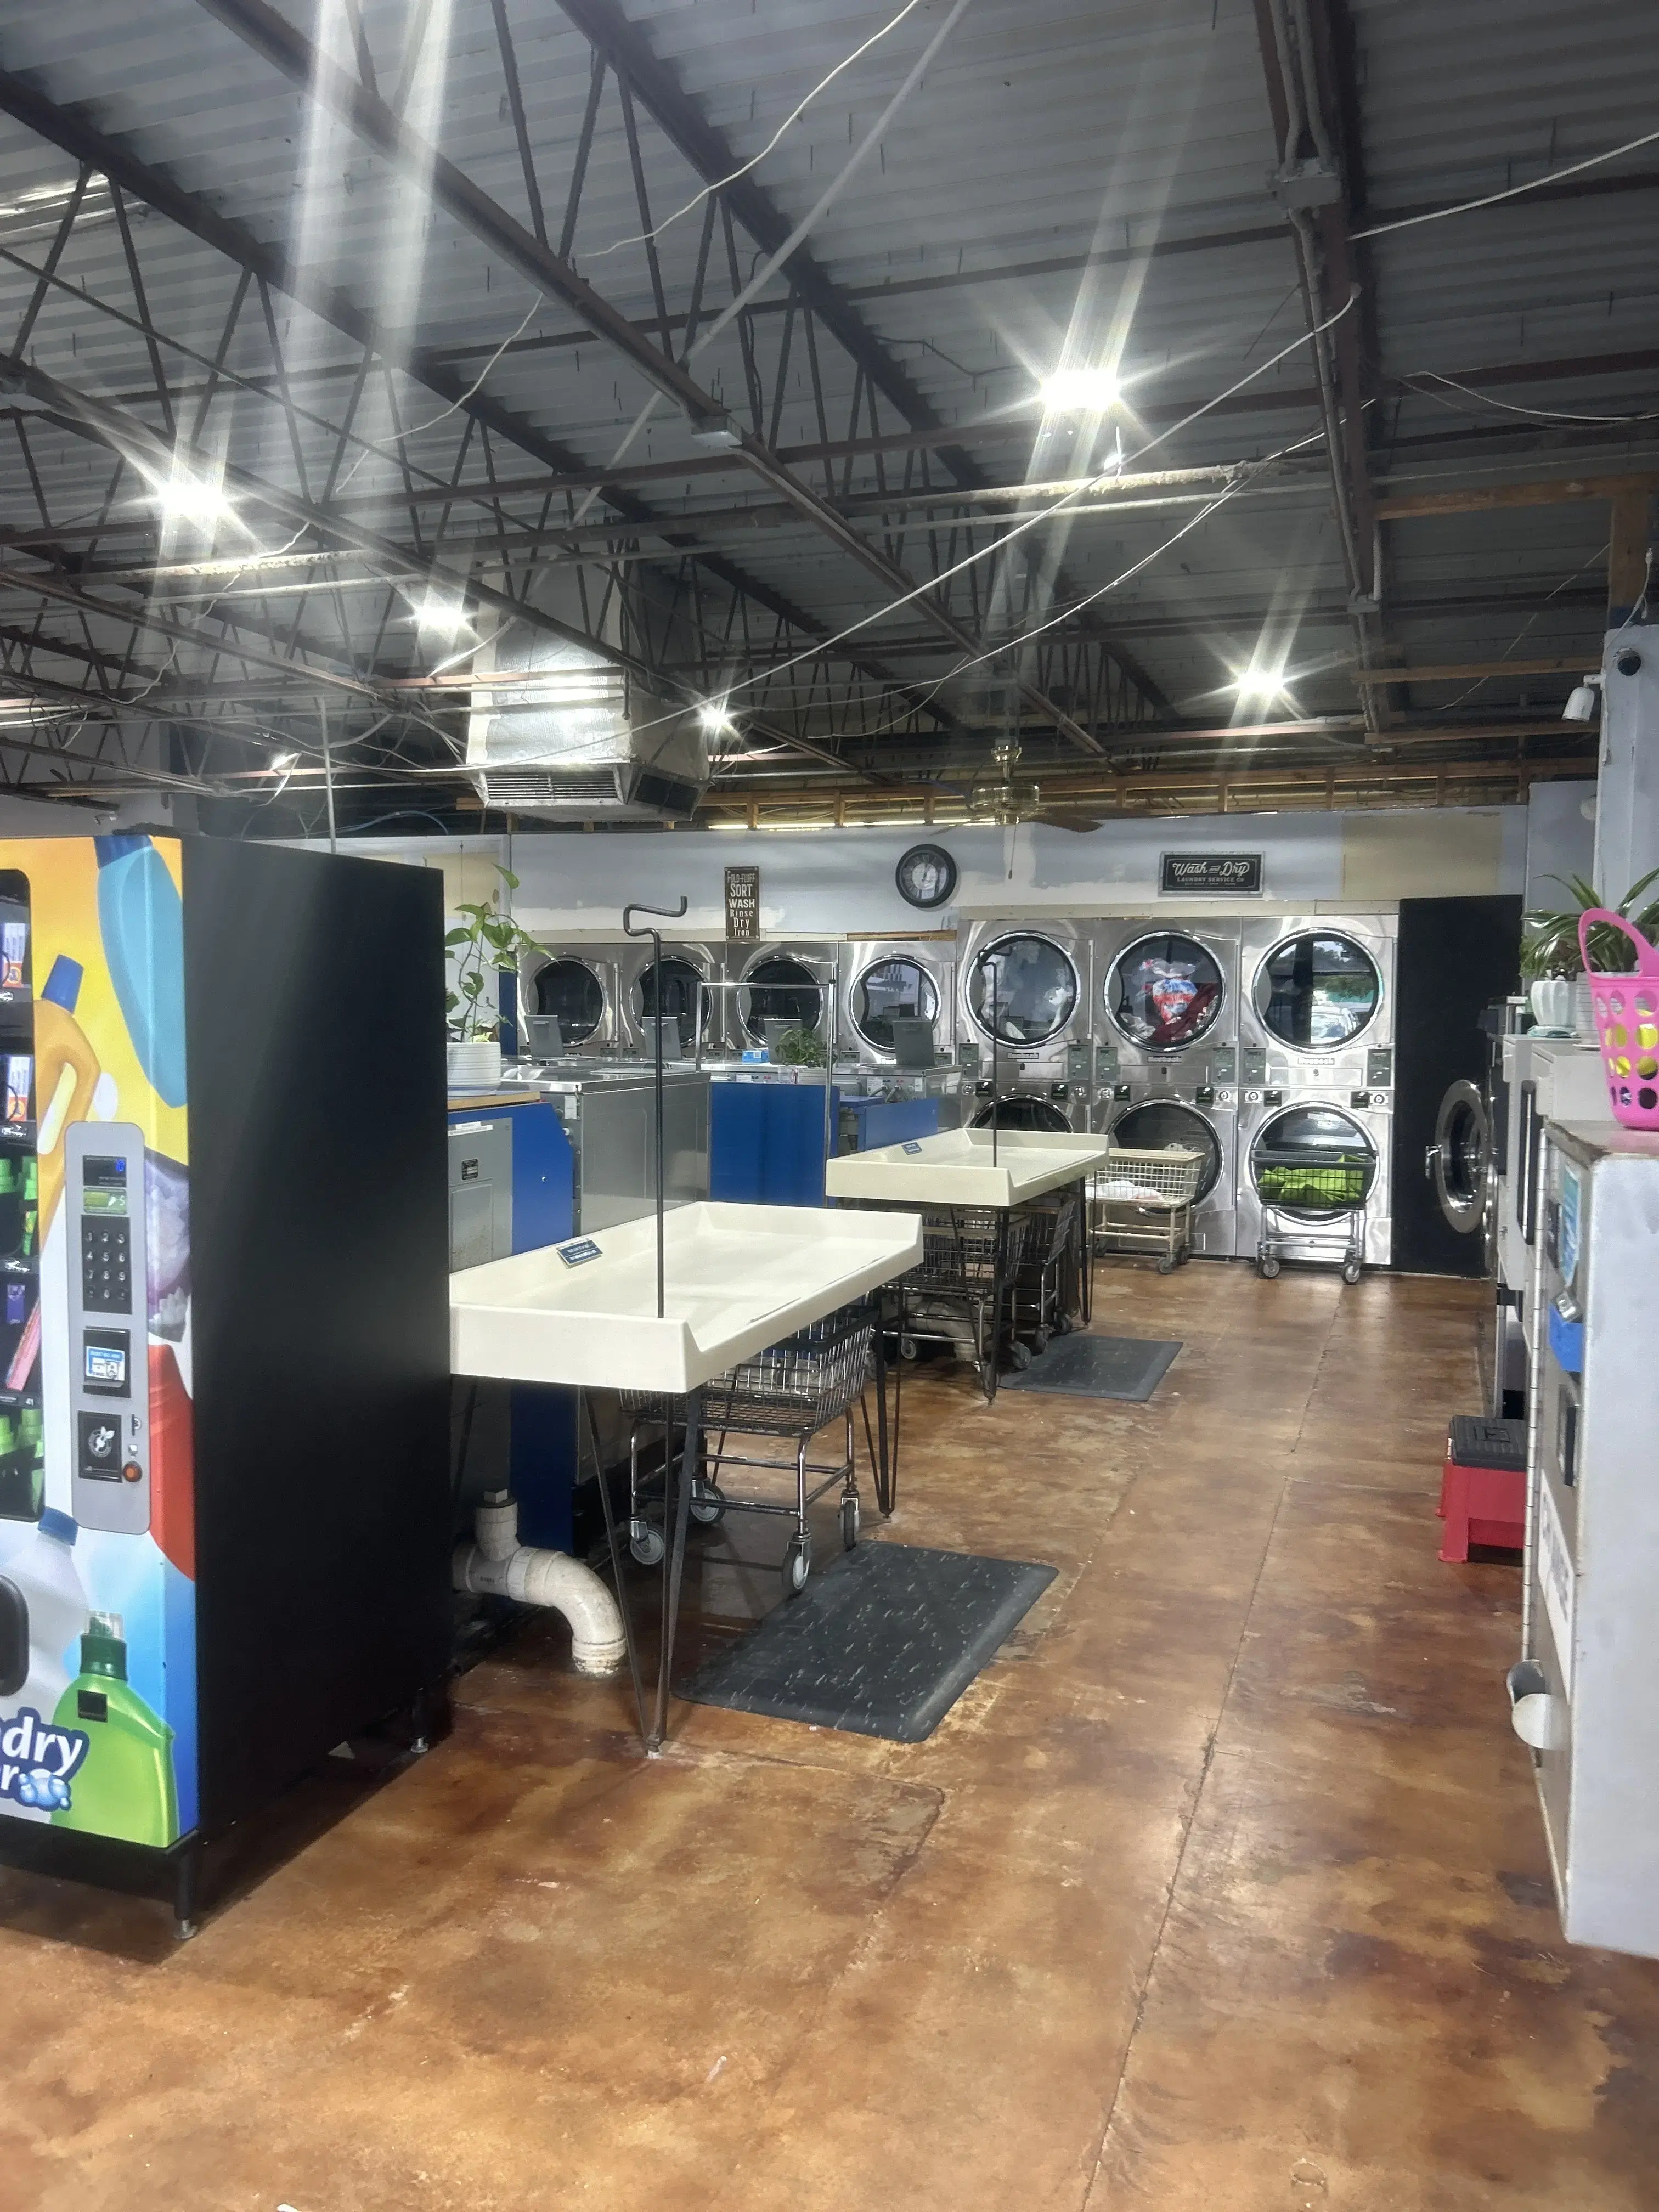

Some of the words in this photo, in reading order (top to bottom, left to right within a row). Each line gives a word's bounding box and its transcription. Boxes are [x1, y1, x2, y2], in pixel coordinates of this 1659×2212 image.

[1172, 861, 1207, 876] Wash
[1219, 861, 1250, 877] Dry
[730, 883, 753, 898] SORT
[728, 898, 755, 909] WASH
[730, 909, 753, 917] Rinse
[733, 917, 750, 929] Dry
[734, 928, 750, 936] Iron
[0, 1716, 83, 1776] dry
[0, 1764, 20, 1790] r
